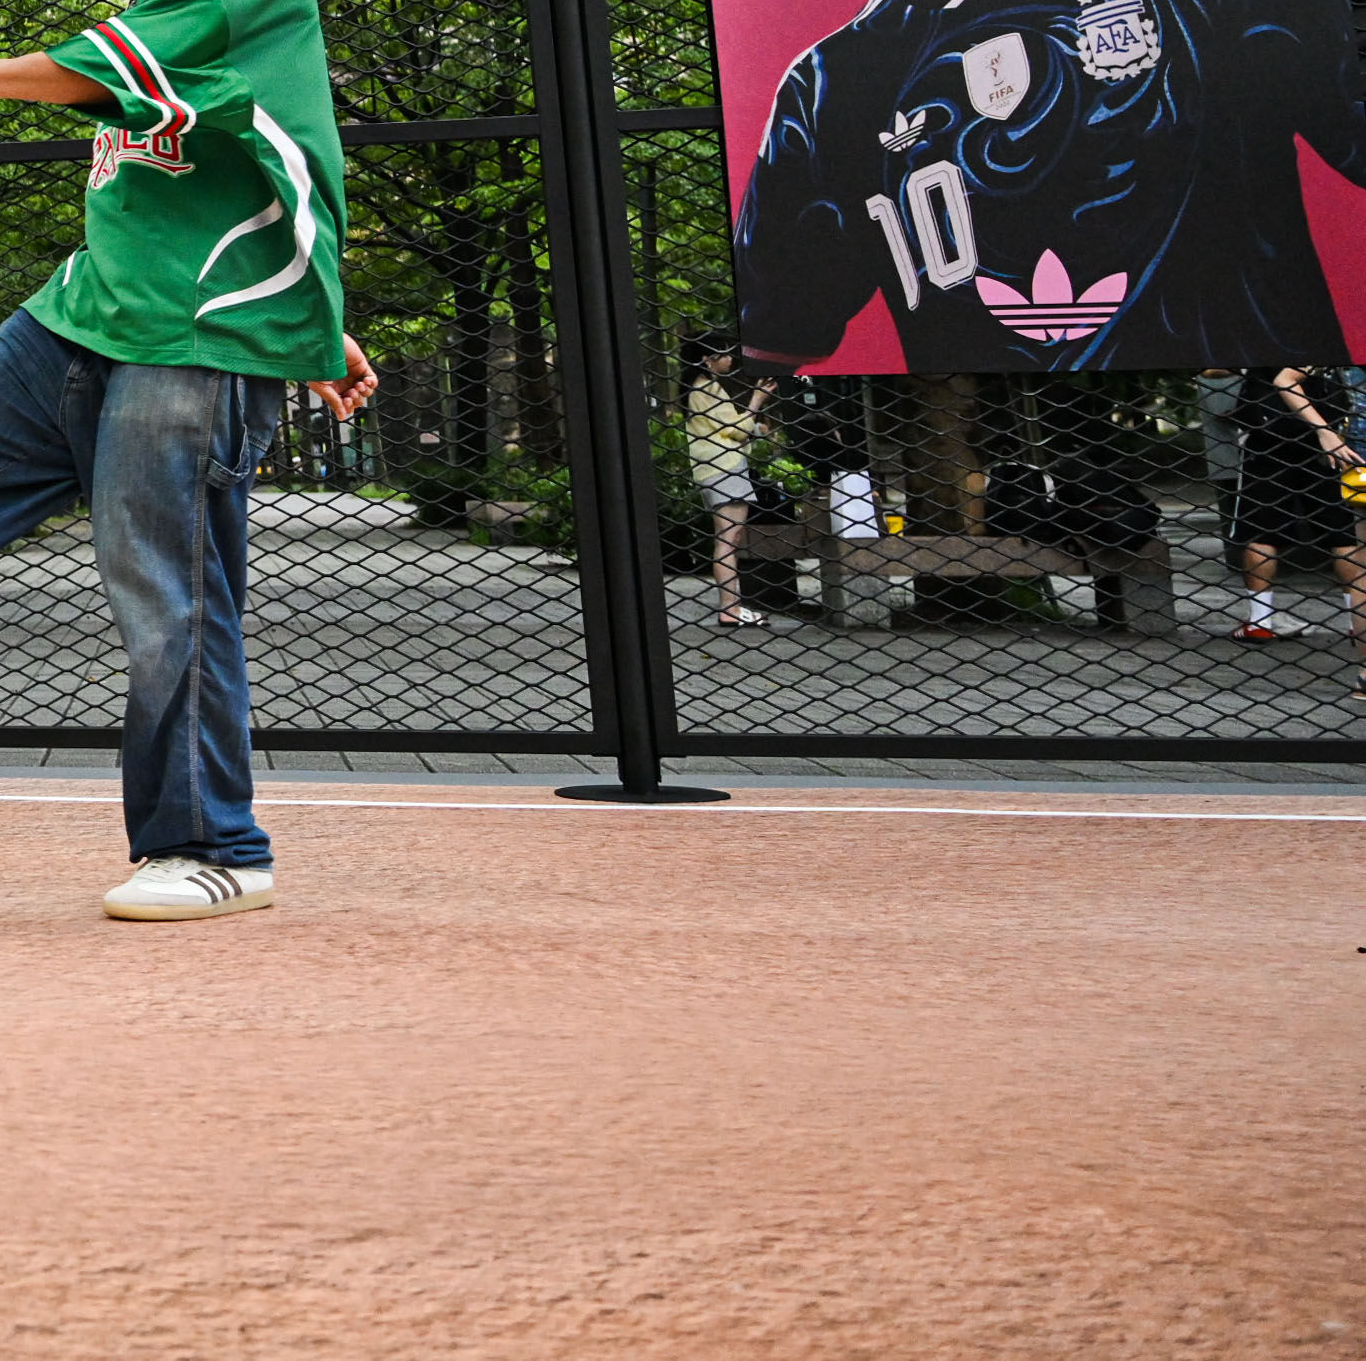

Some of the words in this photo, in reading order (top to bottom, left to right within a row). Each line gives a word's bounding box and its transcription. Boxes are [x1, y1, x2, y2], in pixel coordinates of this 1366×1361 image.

[1094, 23, 1141, 54] AFA
[989, 85, 1014, 103] FIFA
[865, 159, 979, 312] 10
